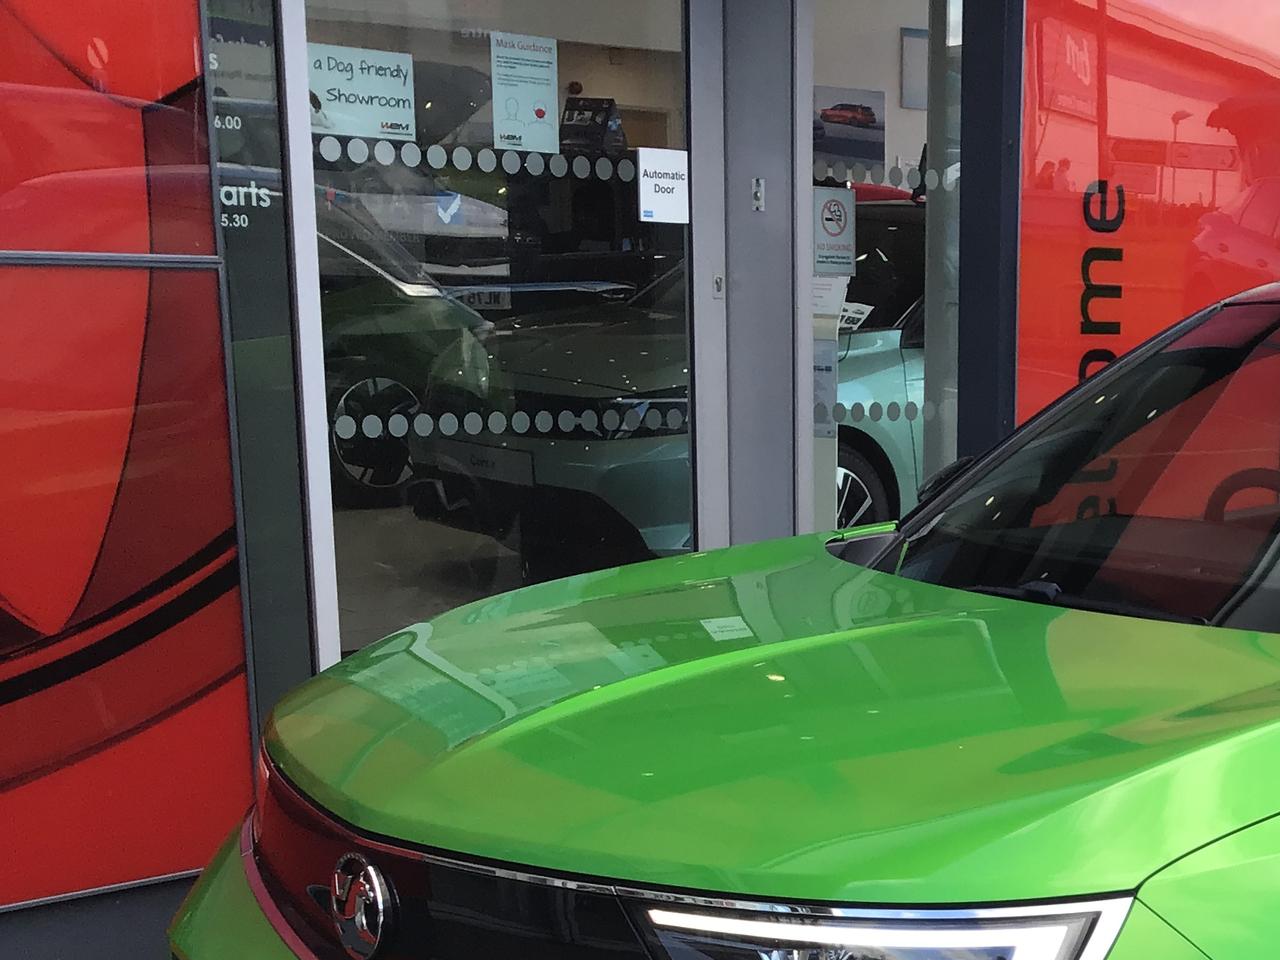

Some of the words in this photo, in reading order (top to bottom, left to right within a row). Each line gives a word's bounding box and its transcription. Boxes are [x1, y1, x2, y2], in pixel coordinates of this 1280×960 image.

[313, 59, 322, 70] a
[327, 56, 354, 81] Dog
[359, 60, 408, 87] friendly
[326, 88, 411, 109] Showroom
[642, 168, 686, 181] Automatic
[219, 180, 271, 208] arts
[654, 184, 675, 194] Door
